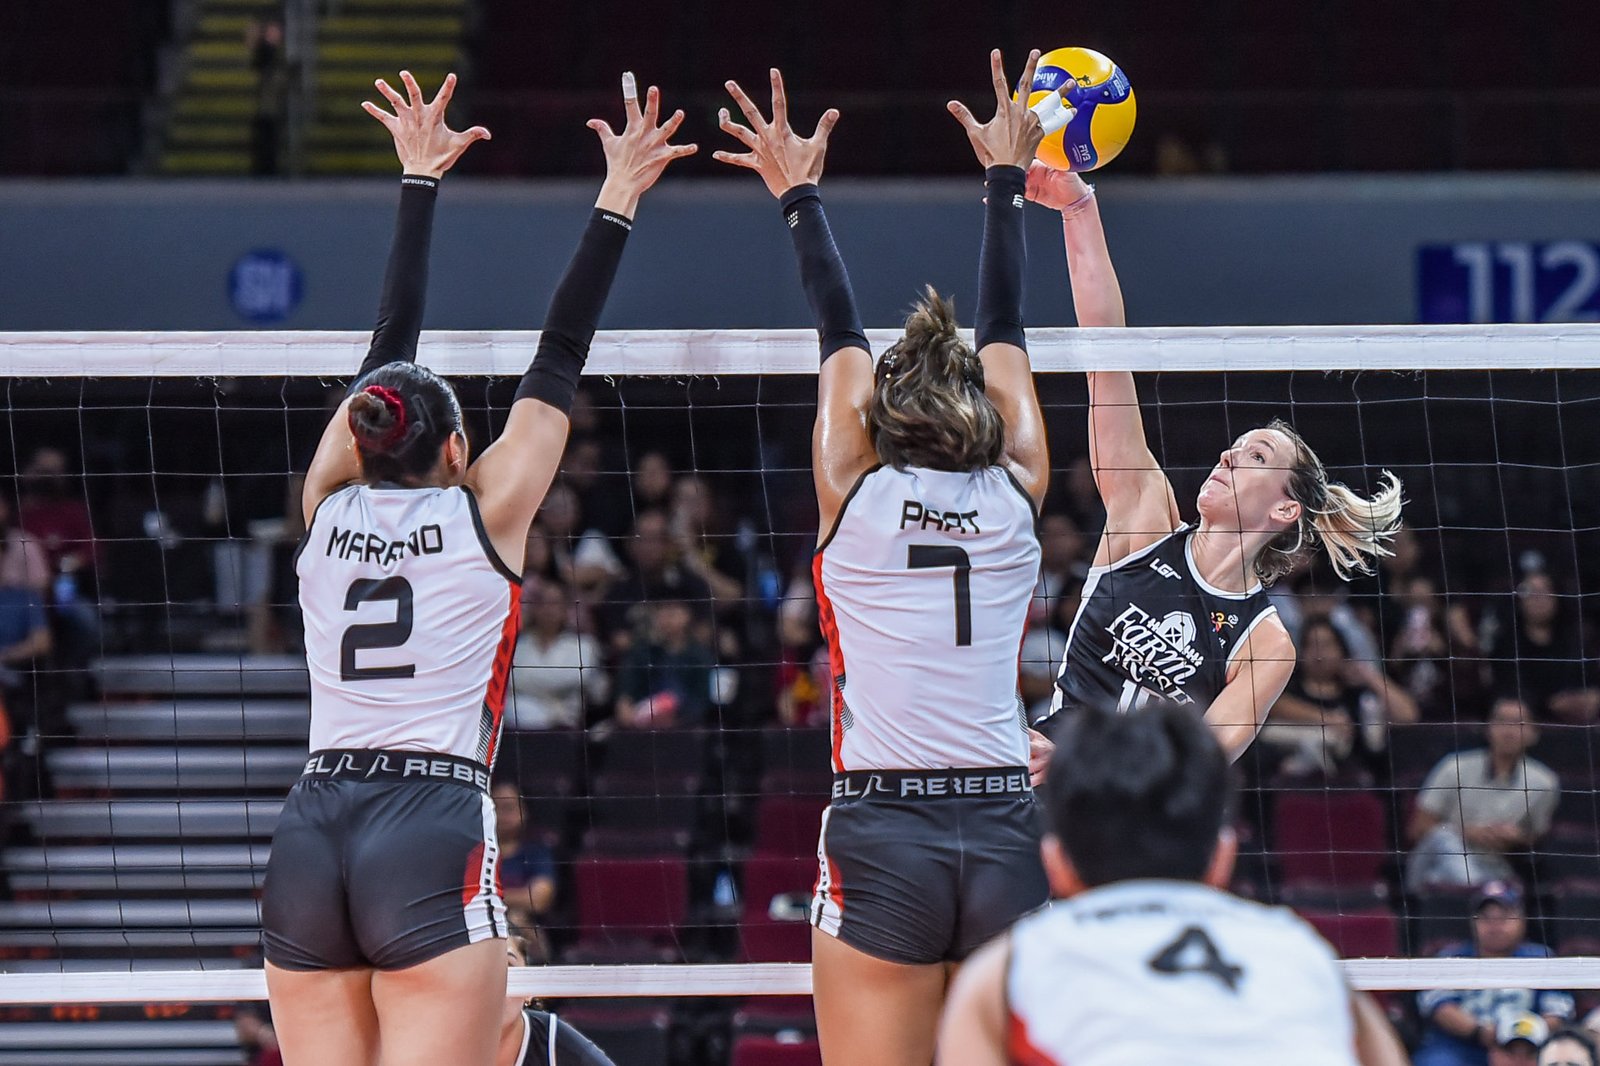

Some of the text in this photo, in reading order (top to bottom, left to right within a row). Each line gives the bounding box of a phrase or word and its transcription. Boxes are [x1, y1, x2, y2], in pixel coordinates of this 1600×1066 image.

[1078, 144, 1091, 162] FIVB
[1453, 243, 1600, 324] 112
[326, 523, 443, 567] MARANO
[340, 575, 415, 682] 2
[907, 544, 972, 646] 7
[1148, 924, 1243, 994] 4
